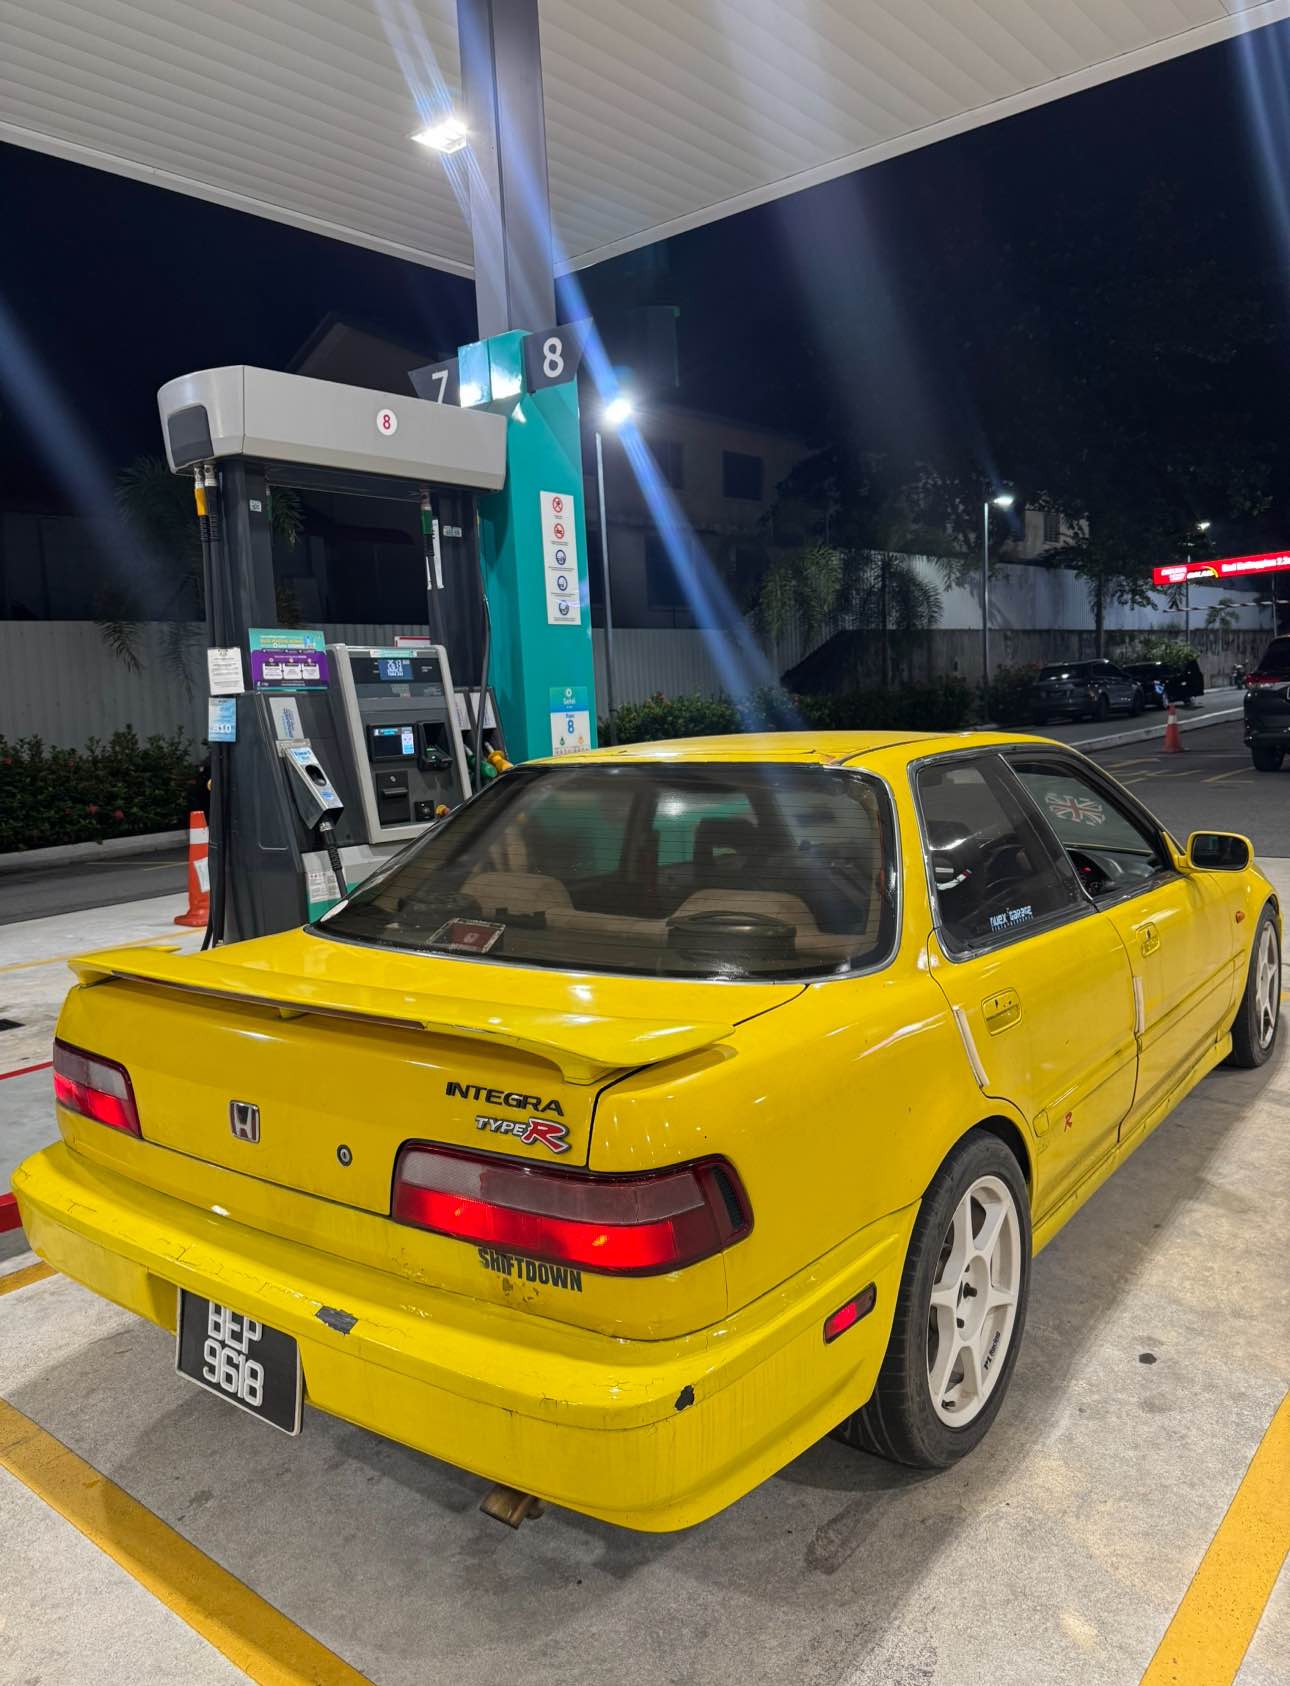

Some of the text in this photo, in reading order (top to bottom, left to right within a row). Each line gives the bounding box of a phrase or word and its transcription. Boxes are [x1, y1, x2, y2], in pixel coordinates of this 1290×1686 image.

[543, 337, 564, 378] 8
[432, 370, 448, 404] 7
[383, 414, 391, 430] 8
[567, 719, 575, 734] 8
[445, 1081, 565, 1117] INTEGRA
[475, 1115, 572, 1154] TYPE R
[208, 1300, 263, 1354] BEP
[203, 1338, 265, 1407] 9618
